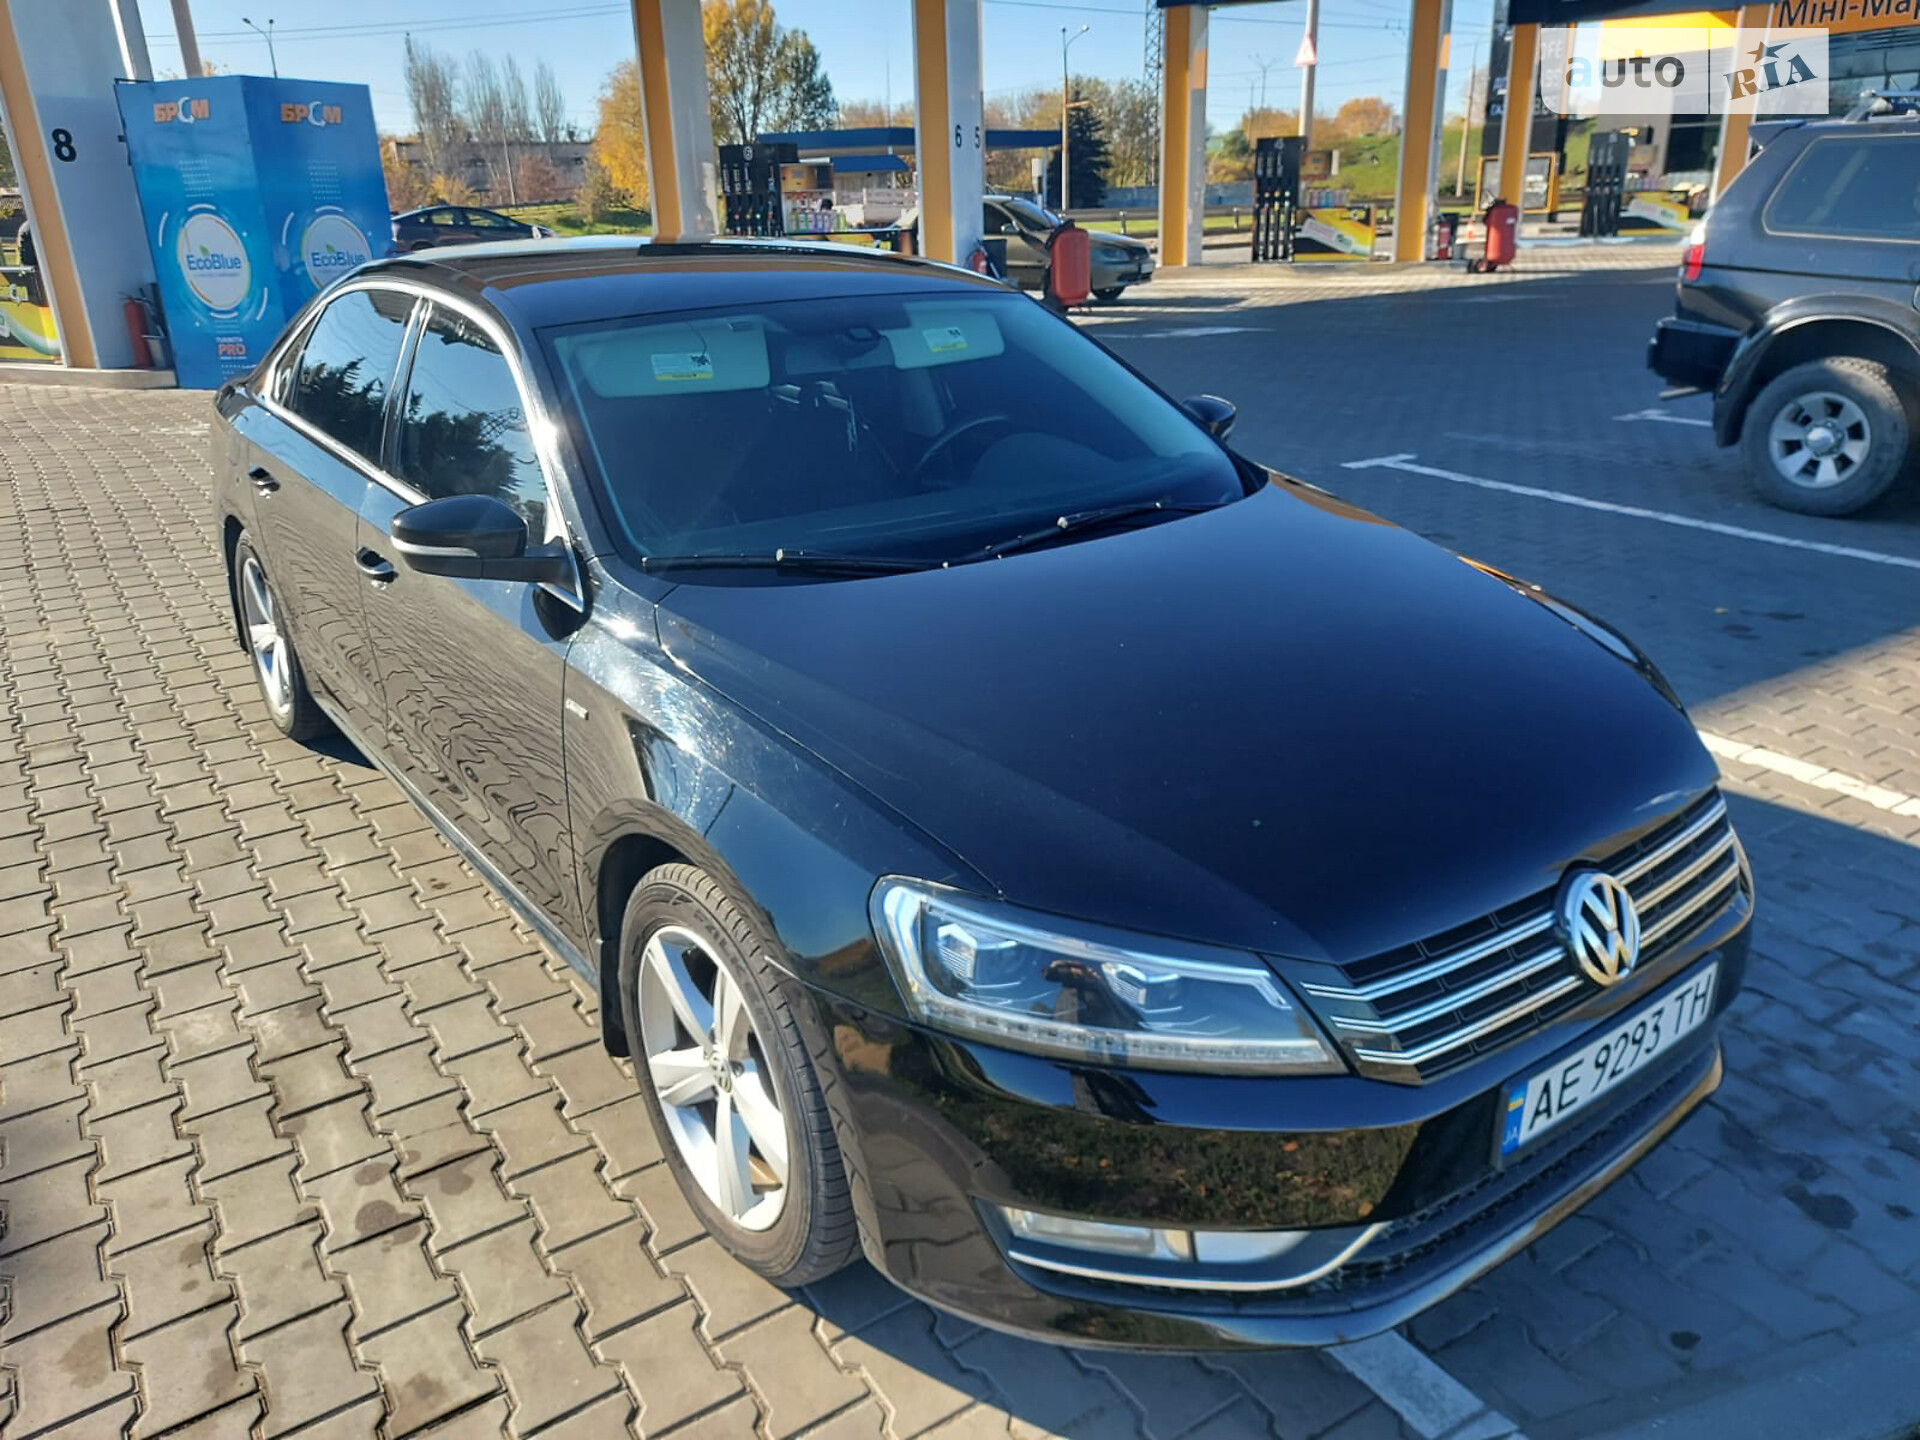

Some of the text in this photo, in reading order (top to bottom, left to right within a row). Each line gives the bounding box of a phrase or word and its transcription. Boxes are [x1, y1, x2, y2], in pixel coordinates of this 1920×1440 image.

[153, 96, 210, 124] БРСМ
[280, 101, 342, 127] БРСМ
[52, 128, 77, 162] 8
[955, 124, 962, 148] 6
[186, 252, 242, 270] EcoBlue
[311, 250, 366, 267] EcoBlue
[218, 344, 246, 356] PRO
[1528, 972, 1712, 1131] AE 9293 TH
